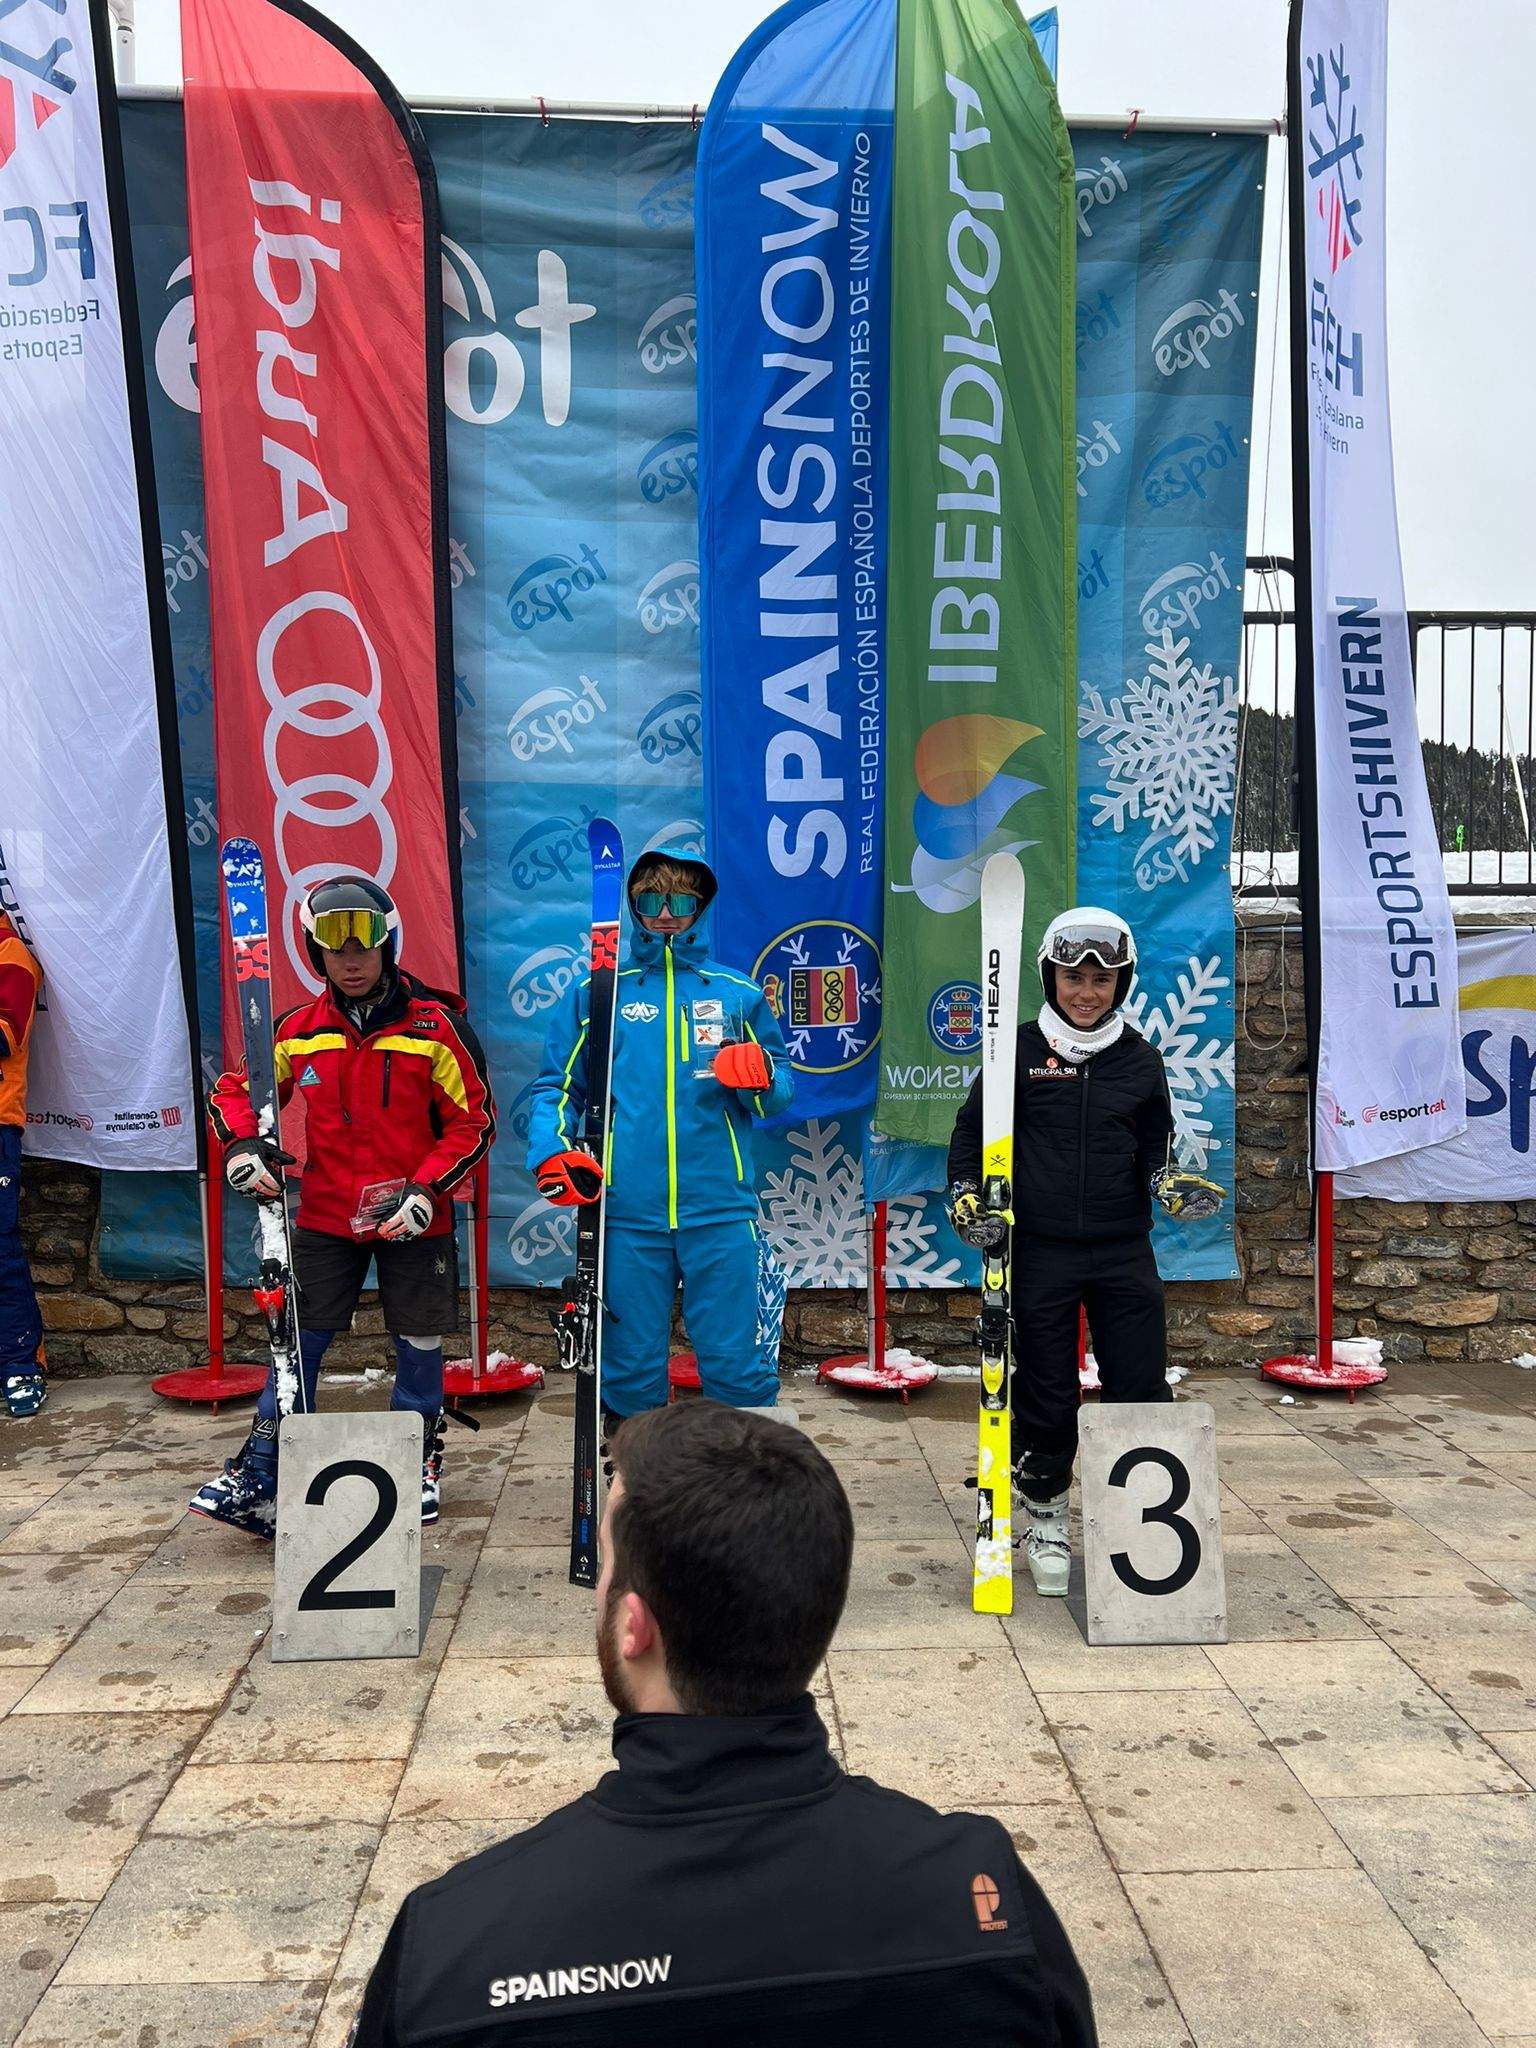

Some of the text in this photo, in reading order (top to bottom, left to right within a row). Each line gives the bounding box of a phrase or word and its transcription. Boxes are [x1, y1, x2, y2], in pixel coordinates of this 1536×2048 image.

[1155, 289, 1245, 377] espot
[757, 122, 848, 880] SPAINSNOW
[849, 132, 880, 875] REAL FEDERACIÓN ESPAÑOLA DEPORTES DE INVIERNO
[1145, 420, 1239, 508] espot
[511, 543, 607, 631] espot
[1142, 551, 1232, 637] espot
[511, 675, 608, 762] espot
[1335, 596, 1441, 1010] ESPORTSHIVERN
[594, 862, 621, 870] DYNASTAR
[794, 972, 807, 1022] RFEDI
[987, 949, 1000, 1028] HEAD
[1380, 1098, 1447, 1123] esportcat
[300, 1461, 396, 1609] 2
[1108, 1446, 1202, 1596] 3
[489, 1954, 673, 2008] SPAINSNOW
